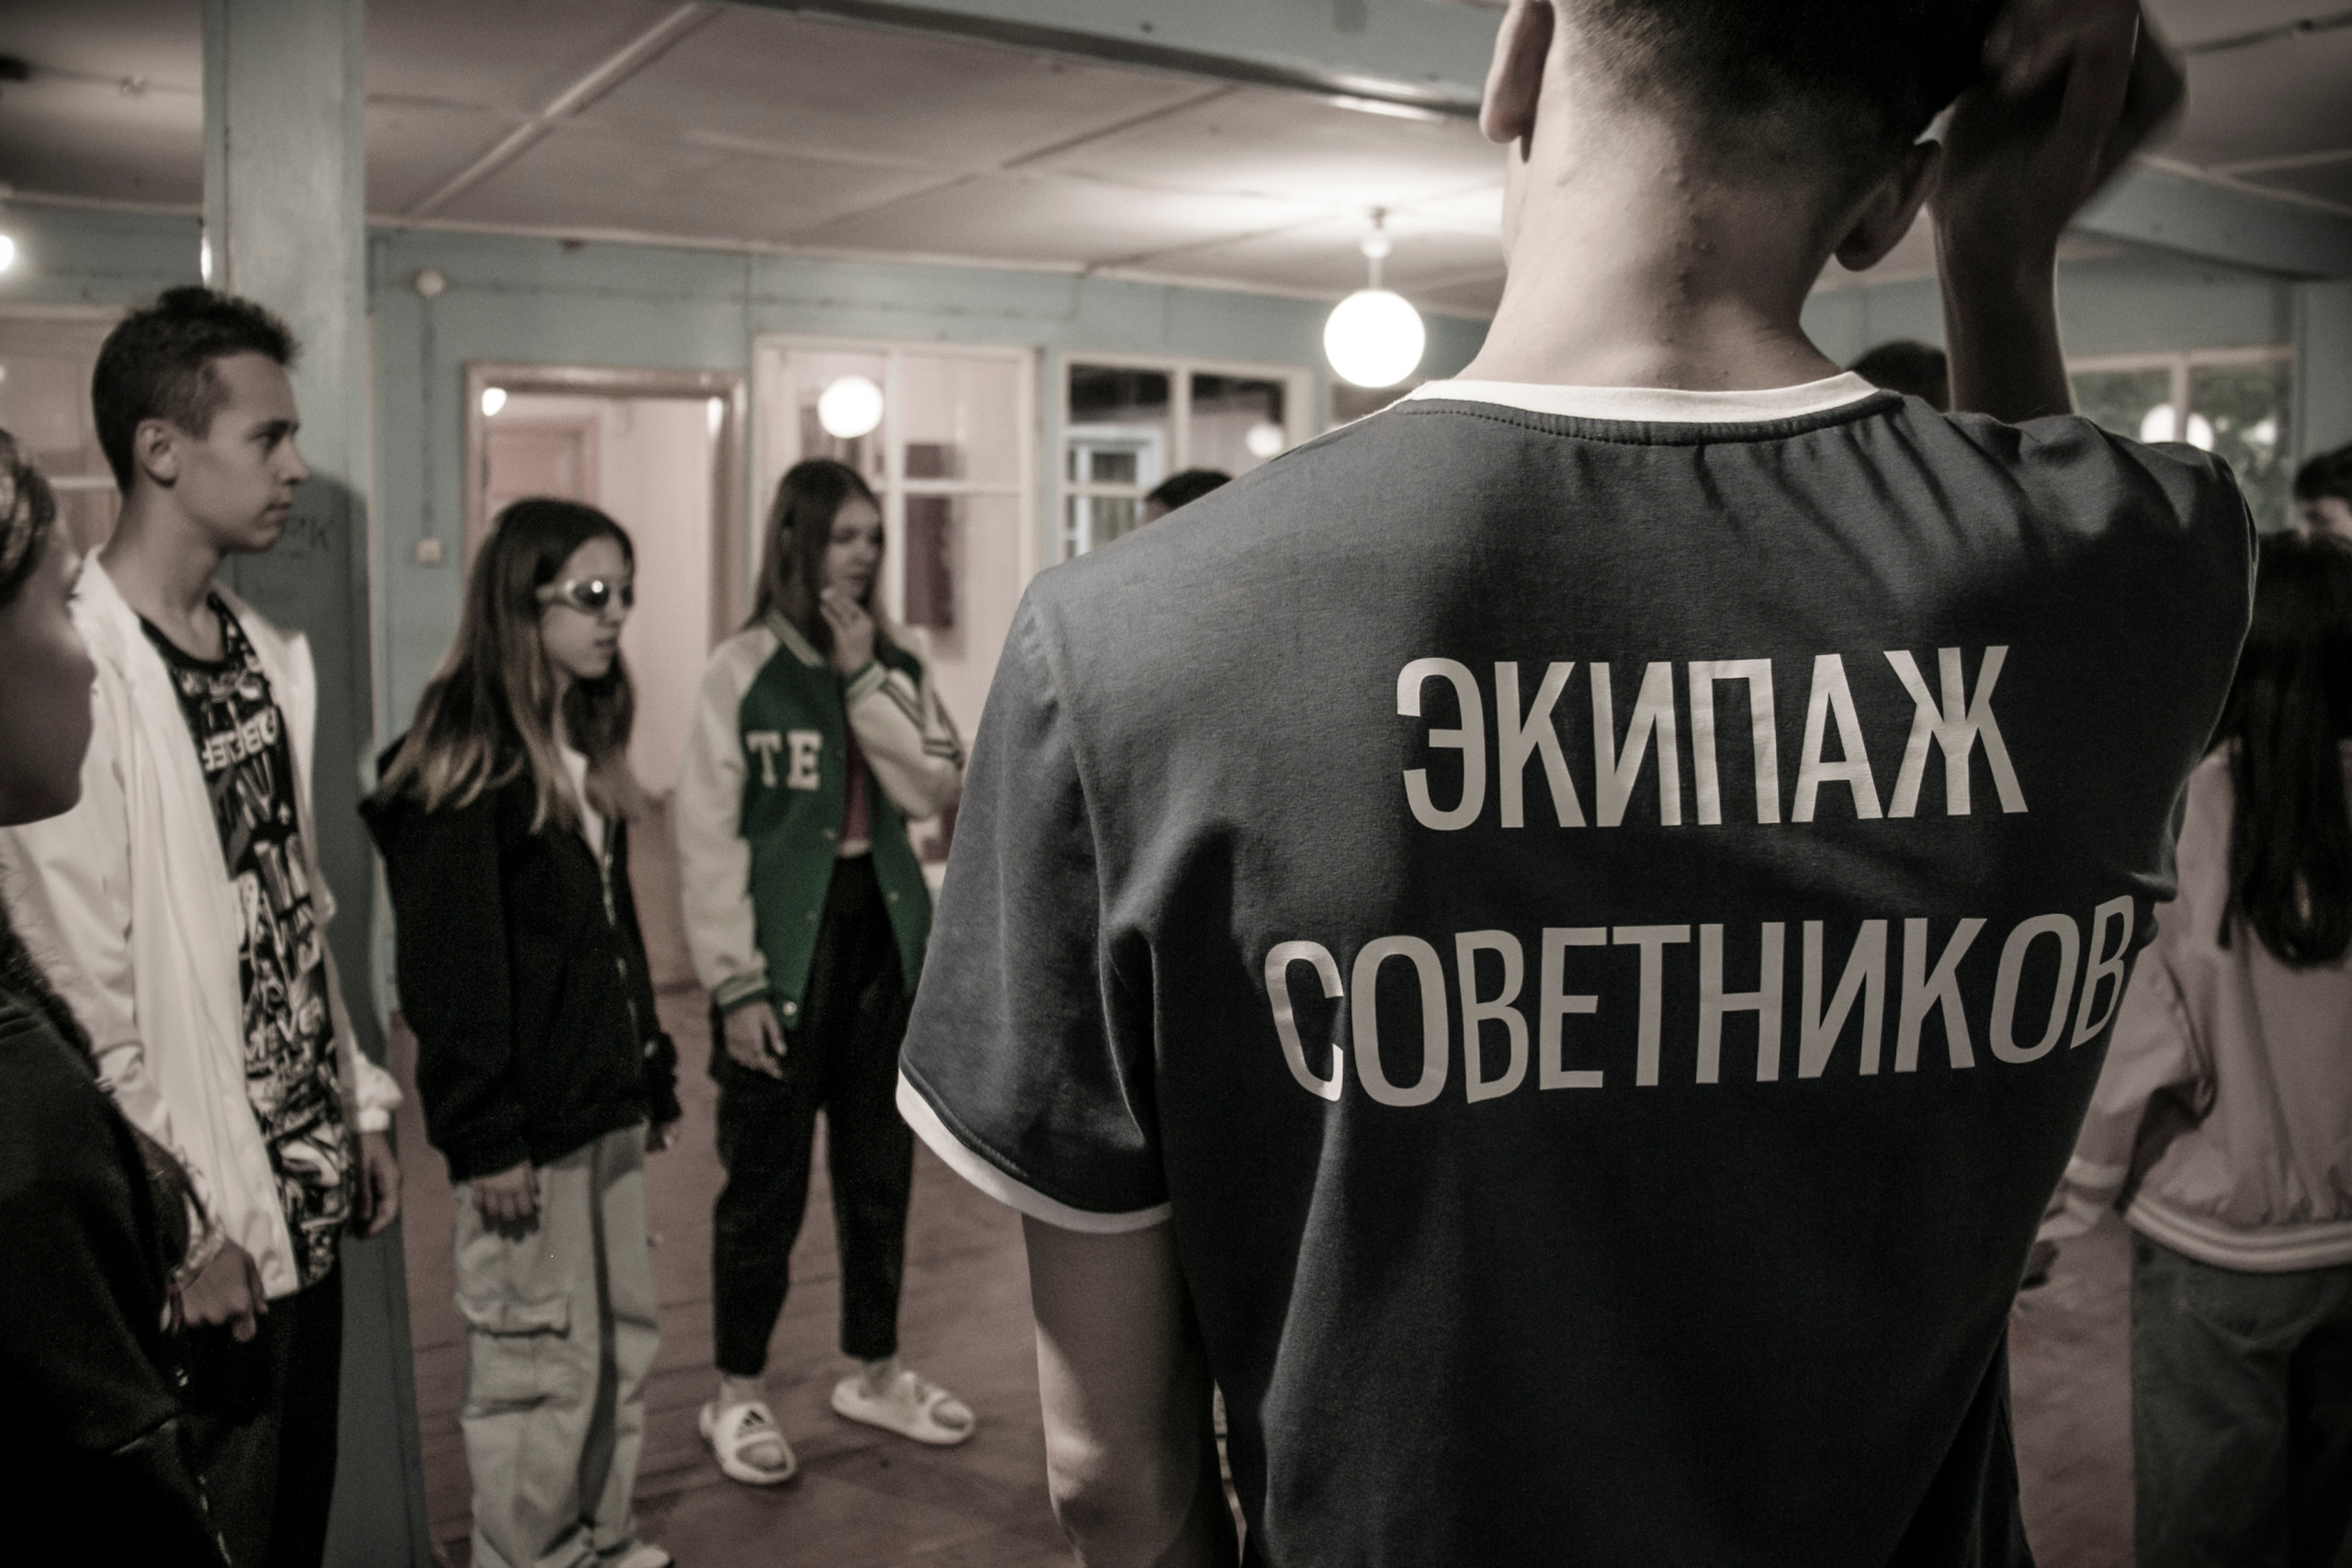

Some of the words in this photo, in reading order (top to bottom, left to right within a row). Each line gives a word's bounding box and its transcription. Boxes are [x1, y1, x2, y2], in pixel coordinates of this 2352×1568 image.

[746, 731, 822, 790] TE
[1396, 646, 2028, 830] ЭКИПАЖ
[1264, 895, 2134, 1107] СОВЕТНИКОВ
